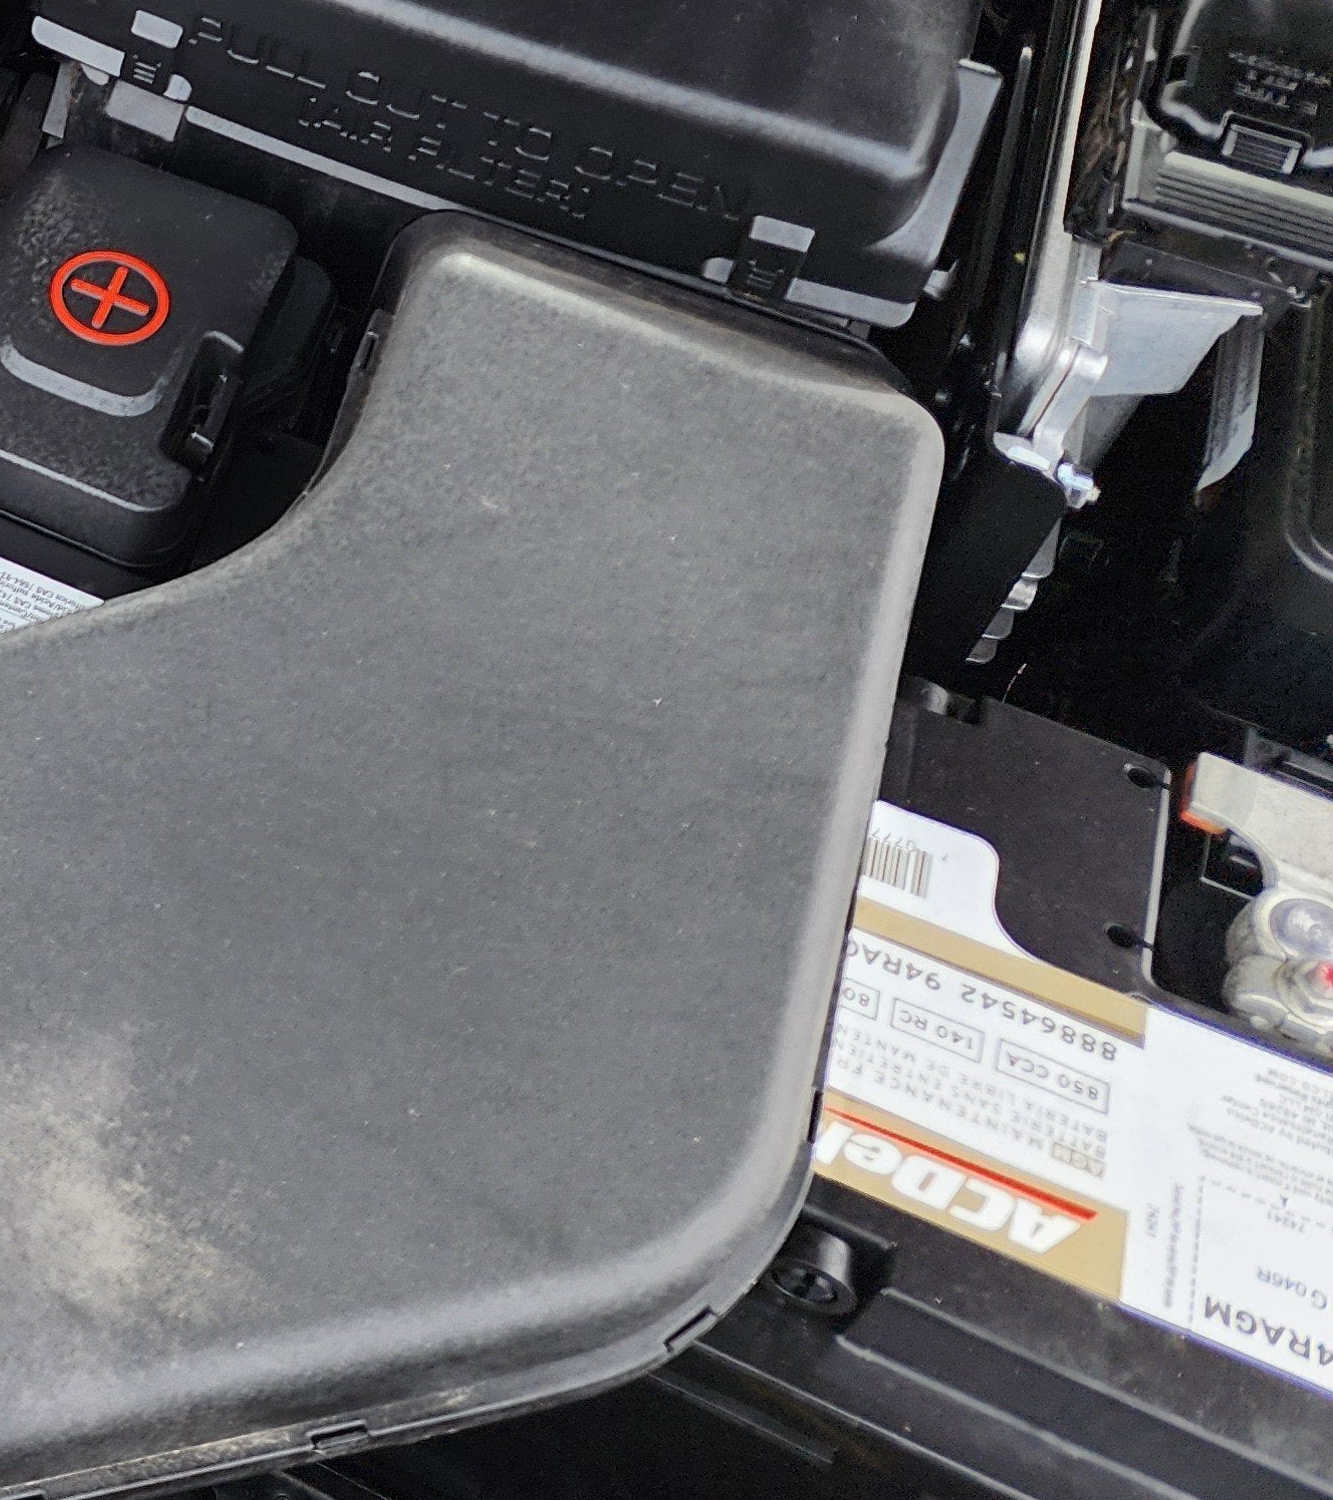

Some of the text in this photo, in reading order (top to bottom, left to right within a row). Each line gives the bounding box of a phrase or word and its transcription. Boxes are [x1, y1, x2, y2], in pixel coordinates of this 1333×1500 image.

[186, 13, 749, 221] PULL OUT TO OPEN
[897, 1007, 974, 1050] 140 RC
[957, 982, 1117, 1062] 88864542
[948, 1084, 1001, 1115] SANS
[955, 1070, 1016, 1105] LIBRE
[1003, 1051, 1098, 1101] 850 CCA
[867, 1068, 1044, 1150] MAINTENANCE
